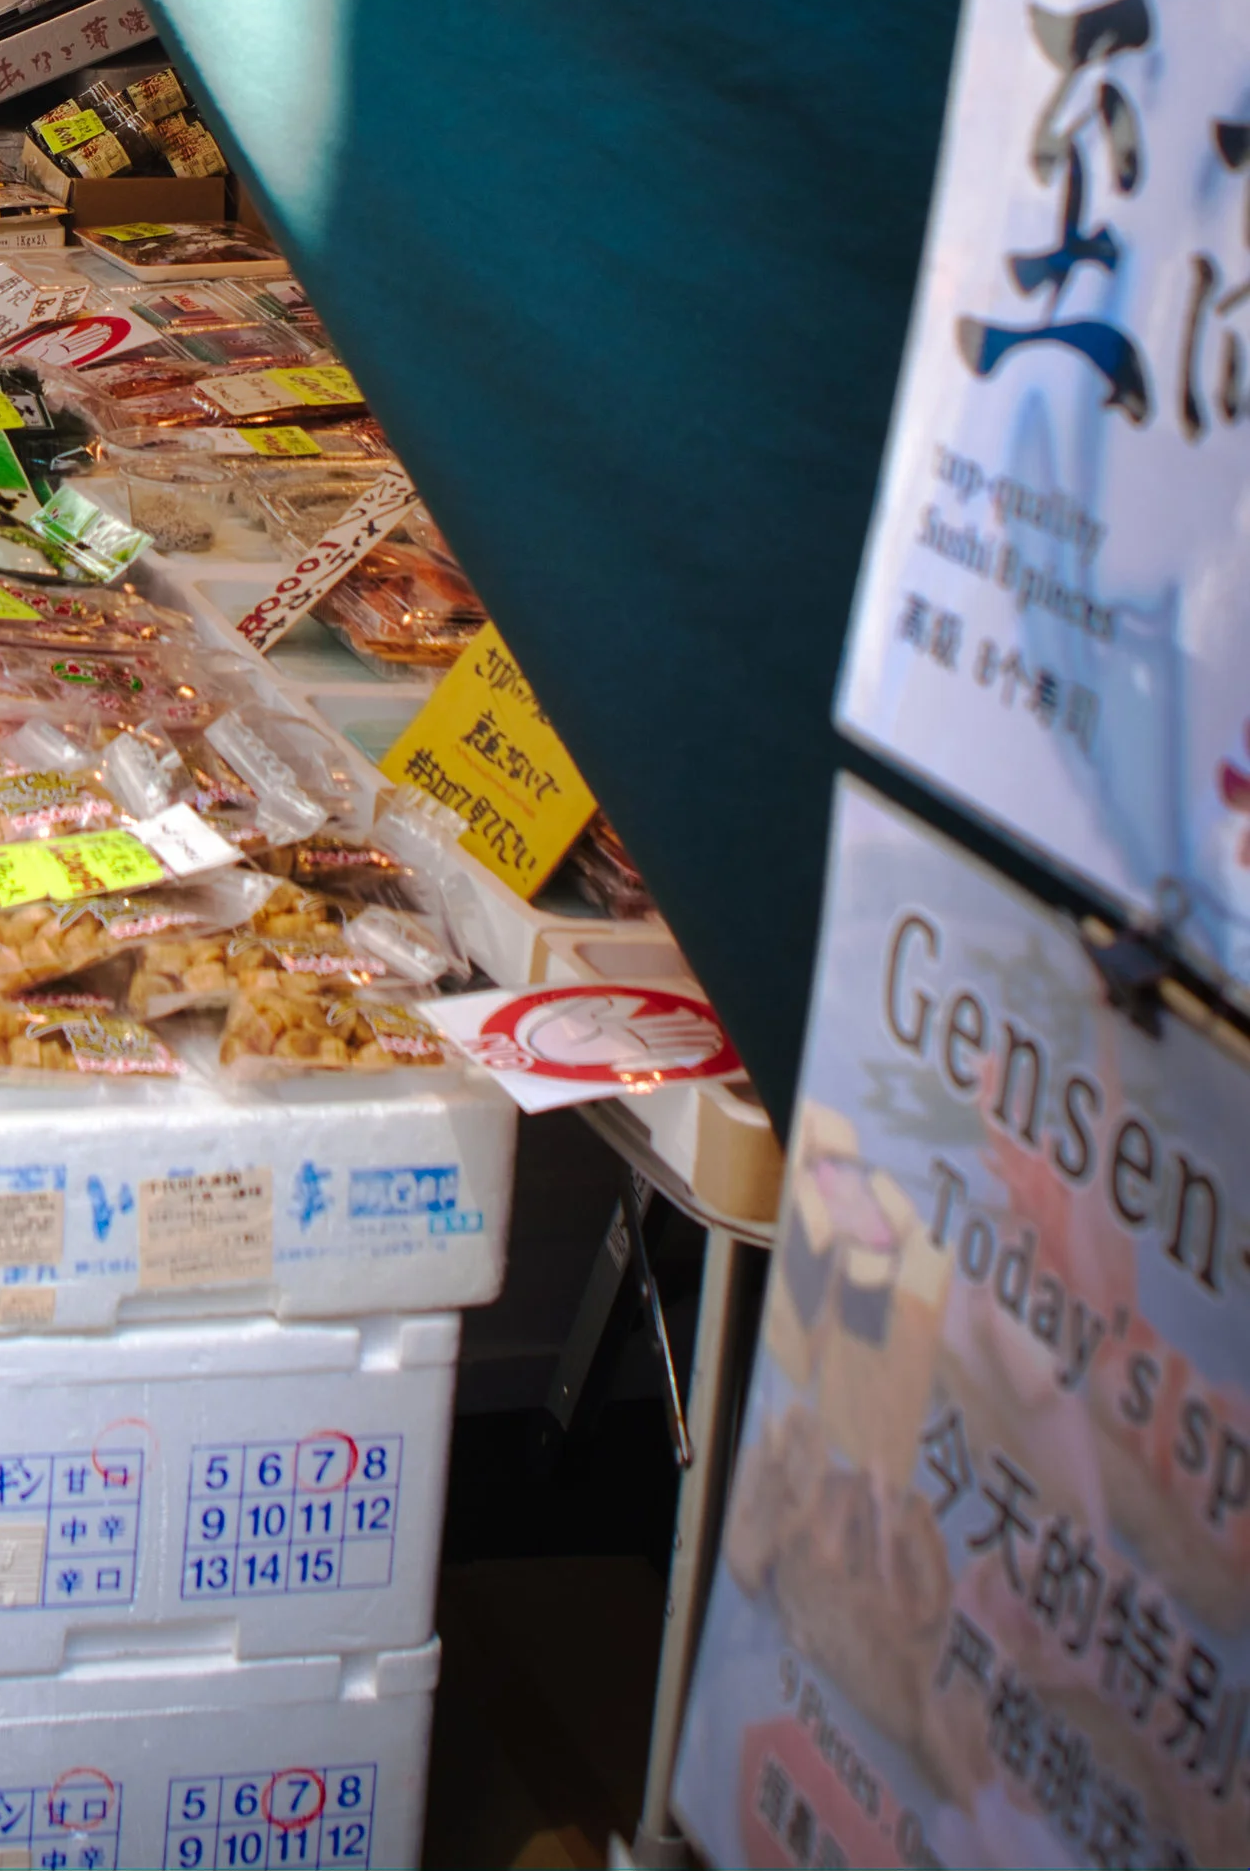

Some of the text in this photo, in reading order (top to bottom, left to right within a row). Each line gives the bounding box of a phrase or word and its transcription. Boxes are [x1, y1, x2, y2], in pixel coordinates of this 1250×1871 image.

[930, 1156, 1163, 1422] Today's
[63, 1464, 129, 1493] 甘口
[206, 1455, 228, 1490] 5
[258, 1453, 282, 1487] 6
[312, 1449, 335, 1484] 7
[362, 1446, 387, 1481] 8
[61, 1515, 124, 1546] 中辛
[202, 1506, 225, 1540] 9
[248, 1504, 286, 1538] 10
[300, 1500, 332, 1533] 11
[352, 1497, 390, 1530] 12
[57, 1568, 120, 1597] 辛口
[190, 1556, 228, 1589] 13
[244, 1553, 280, 1586] 14
[296, 1549, 334, 1583] 15
[183, 1787, 205, 1820] 5
[235, 1784, 257, 1817] 6
[287, 1781, 310, 1814] 7
[338, 1775, 361, 1809] 8
[180, 1835, 203, 1870] 9
[224, 1831, 262, 1866] 10
[275, 1827, 309, 1861] 11
[328, 1822, 366, 1858] 12
